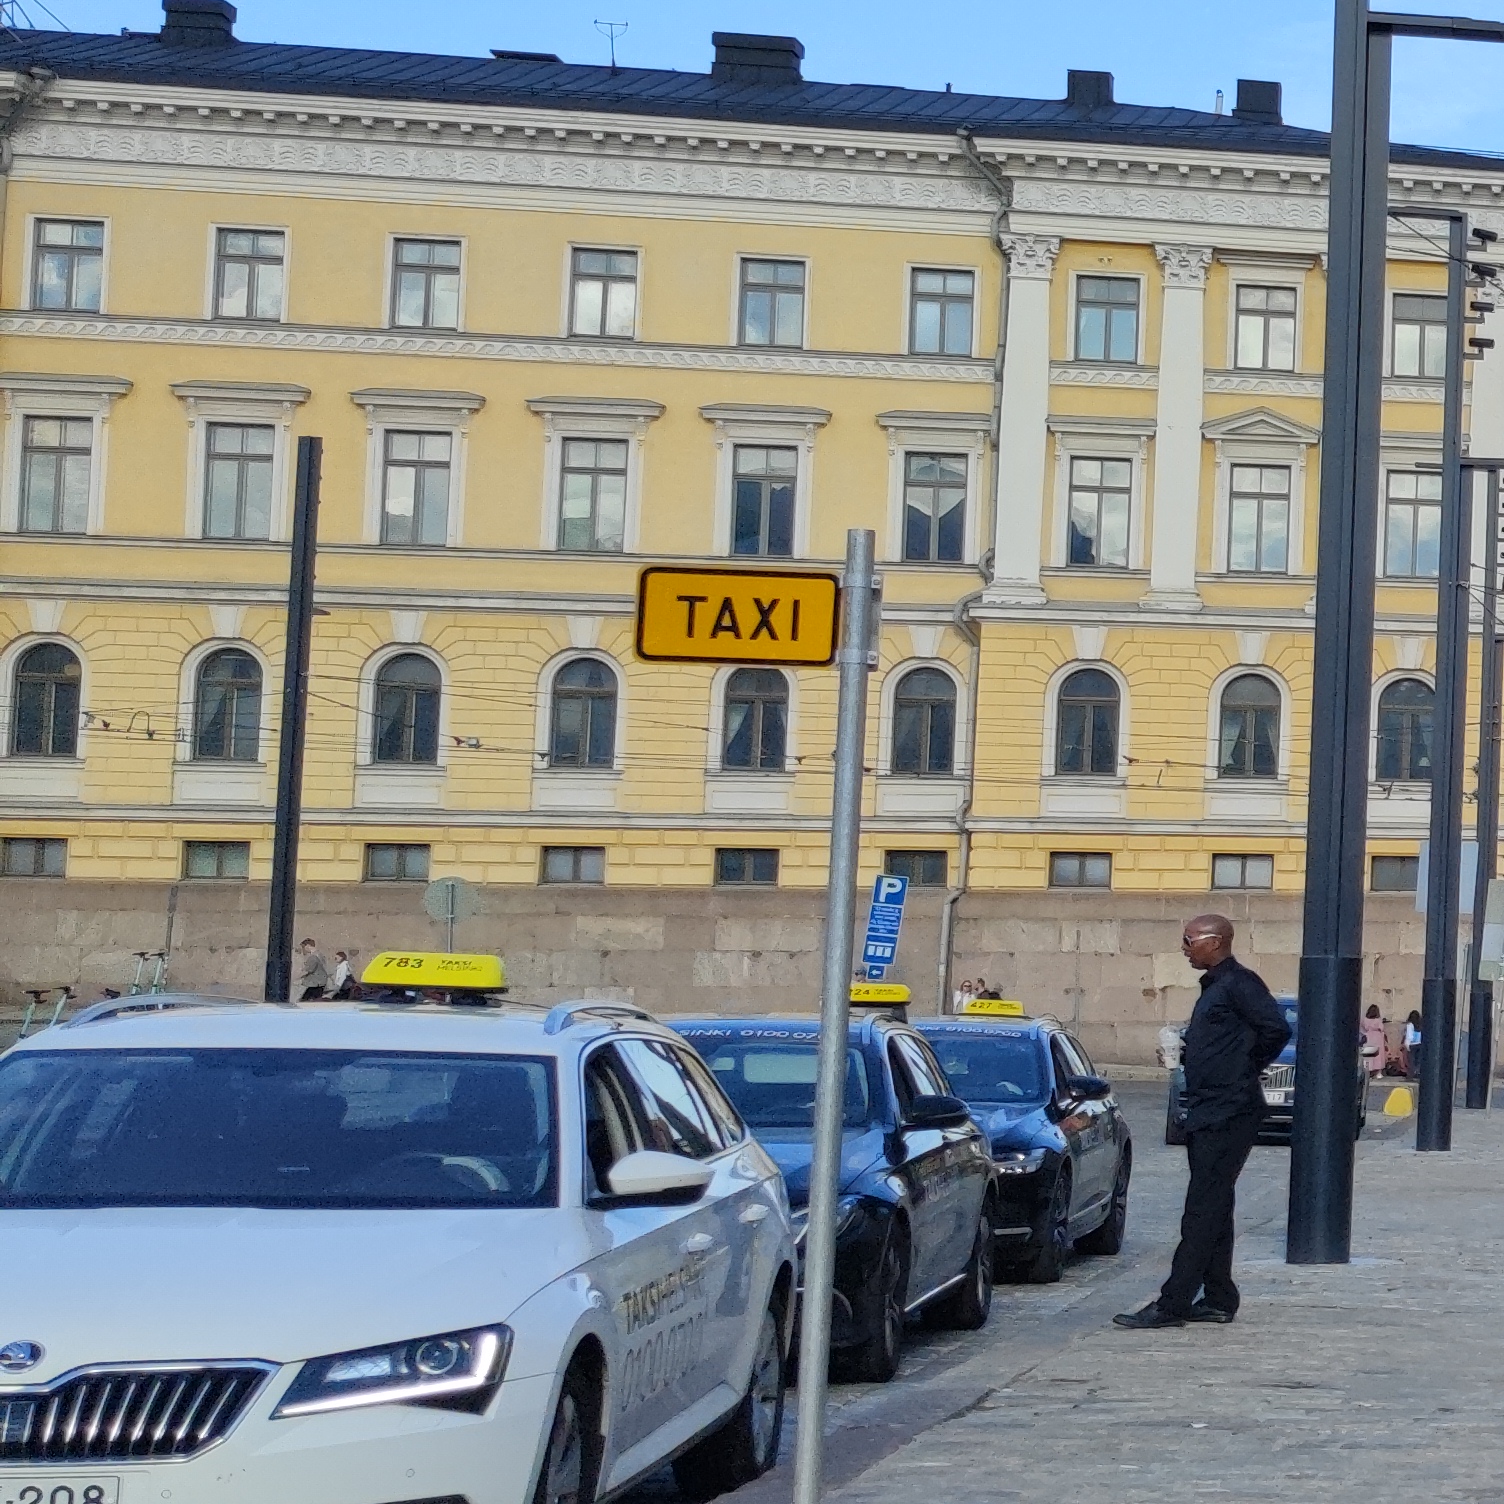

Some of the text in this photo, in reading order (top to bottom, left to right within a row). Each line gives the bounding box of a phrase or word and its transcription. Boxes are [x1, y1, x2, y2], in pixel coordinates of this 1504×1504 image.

[676, 595, 801, 641] TAXI
[383, 957, 424, 969] 783
[740, 1029, 790, 1038] 0100
